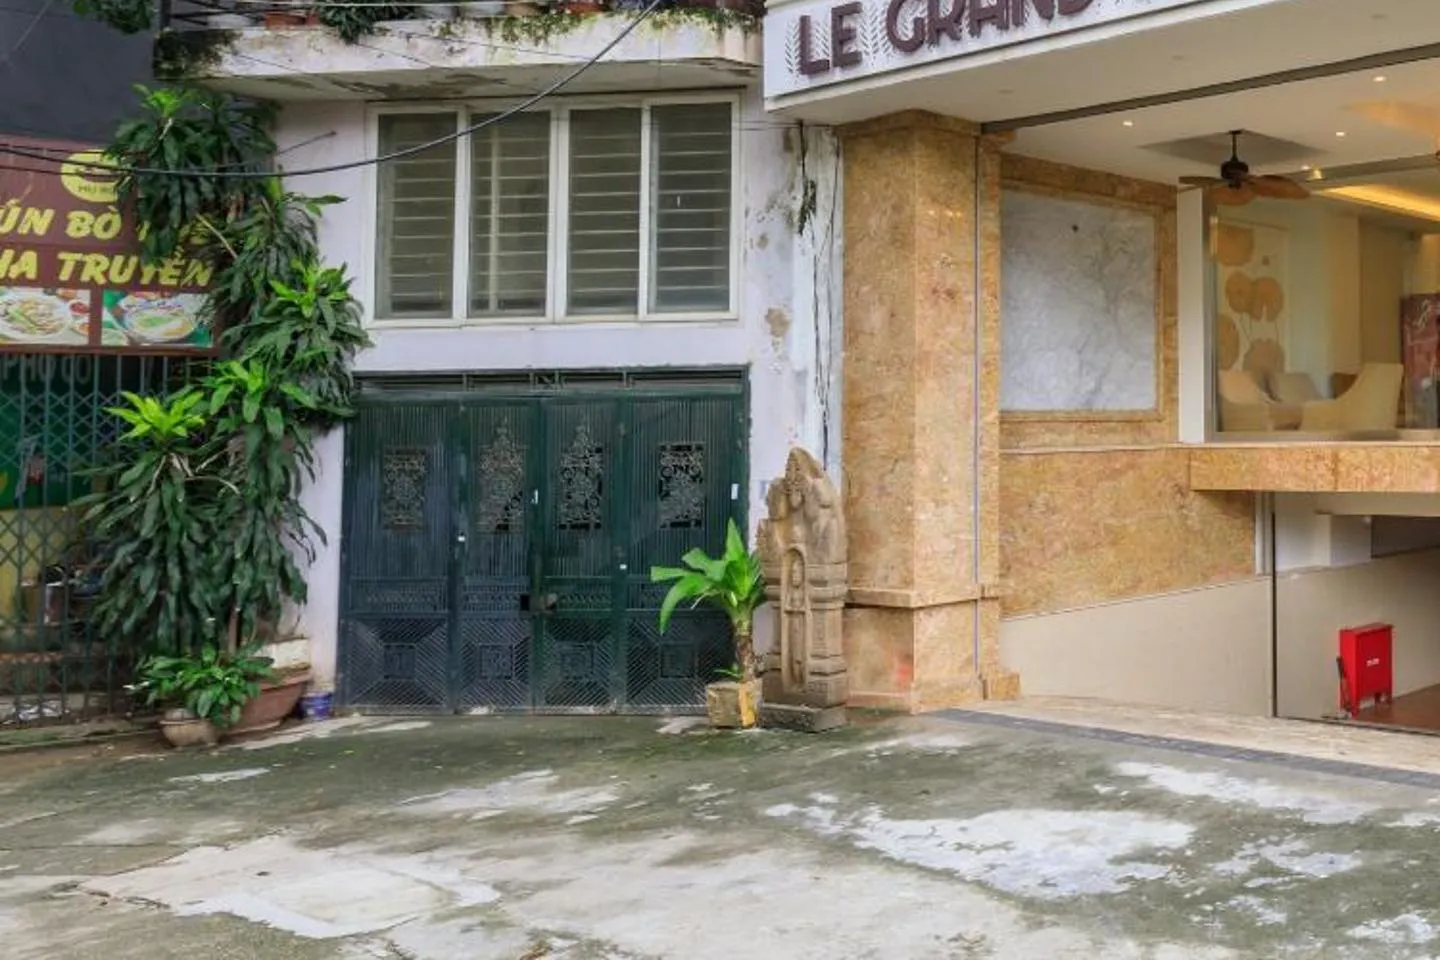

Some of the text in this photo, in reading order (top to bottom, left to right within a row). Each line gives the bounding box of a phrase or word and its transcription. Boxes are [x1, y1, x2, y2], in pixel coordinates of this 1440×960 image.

[799, 1, 861, 76] LE
[0, 199, 55, 235] ÚN
[65, 205, 121, 239] BÒ
